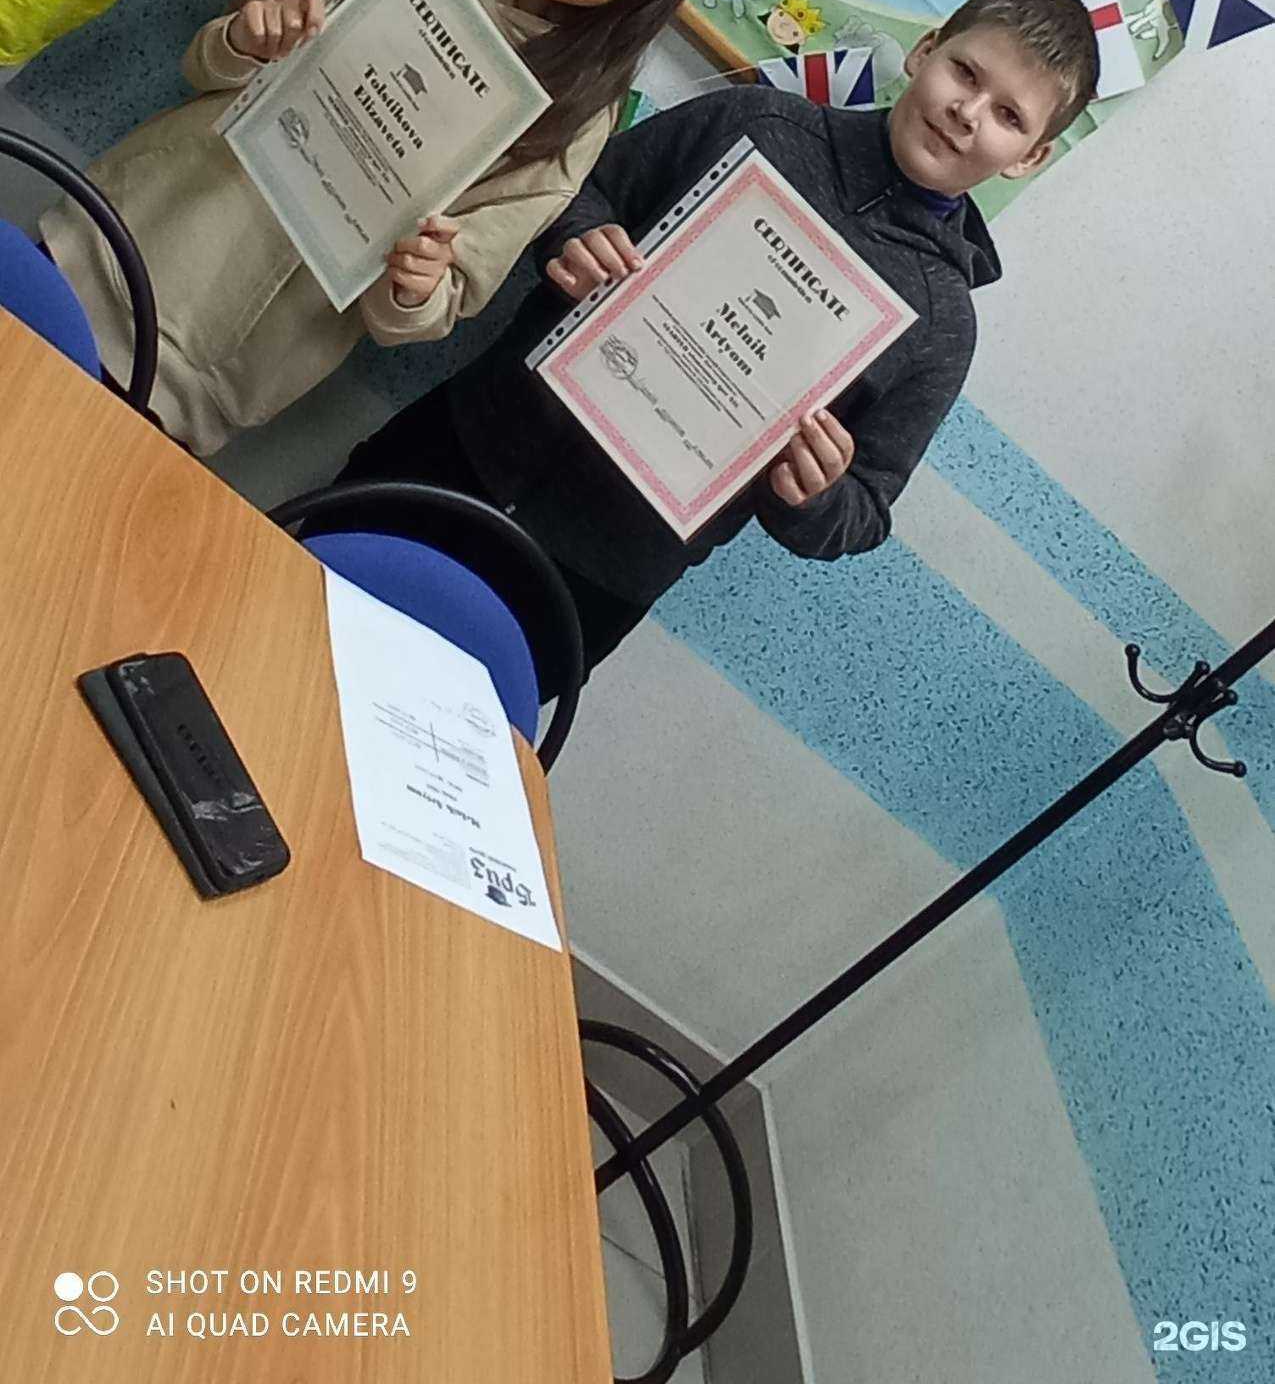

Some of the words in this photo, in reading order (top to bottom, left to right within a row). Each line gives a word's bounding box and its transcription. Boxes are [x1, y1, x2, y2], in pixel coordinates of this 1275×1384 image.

[353, 85, 405, 159] Elizaveta
[363, 64, 424, 149] Tolstikova
[754, 218, 850, 320] CERTIFICATE
[700, 318, 752, 376] Artyom
[717, 303, 767, 360] Melnik
